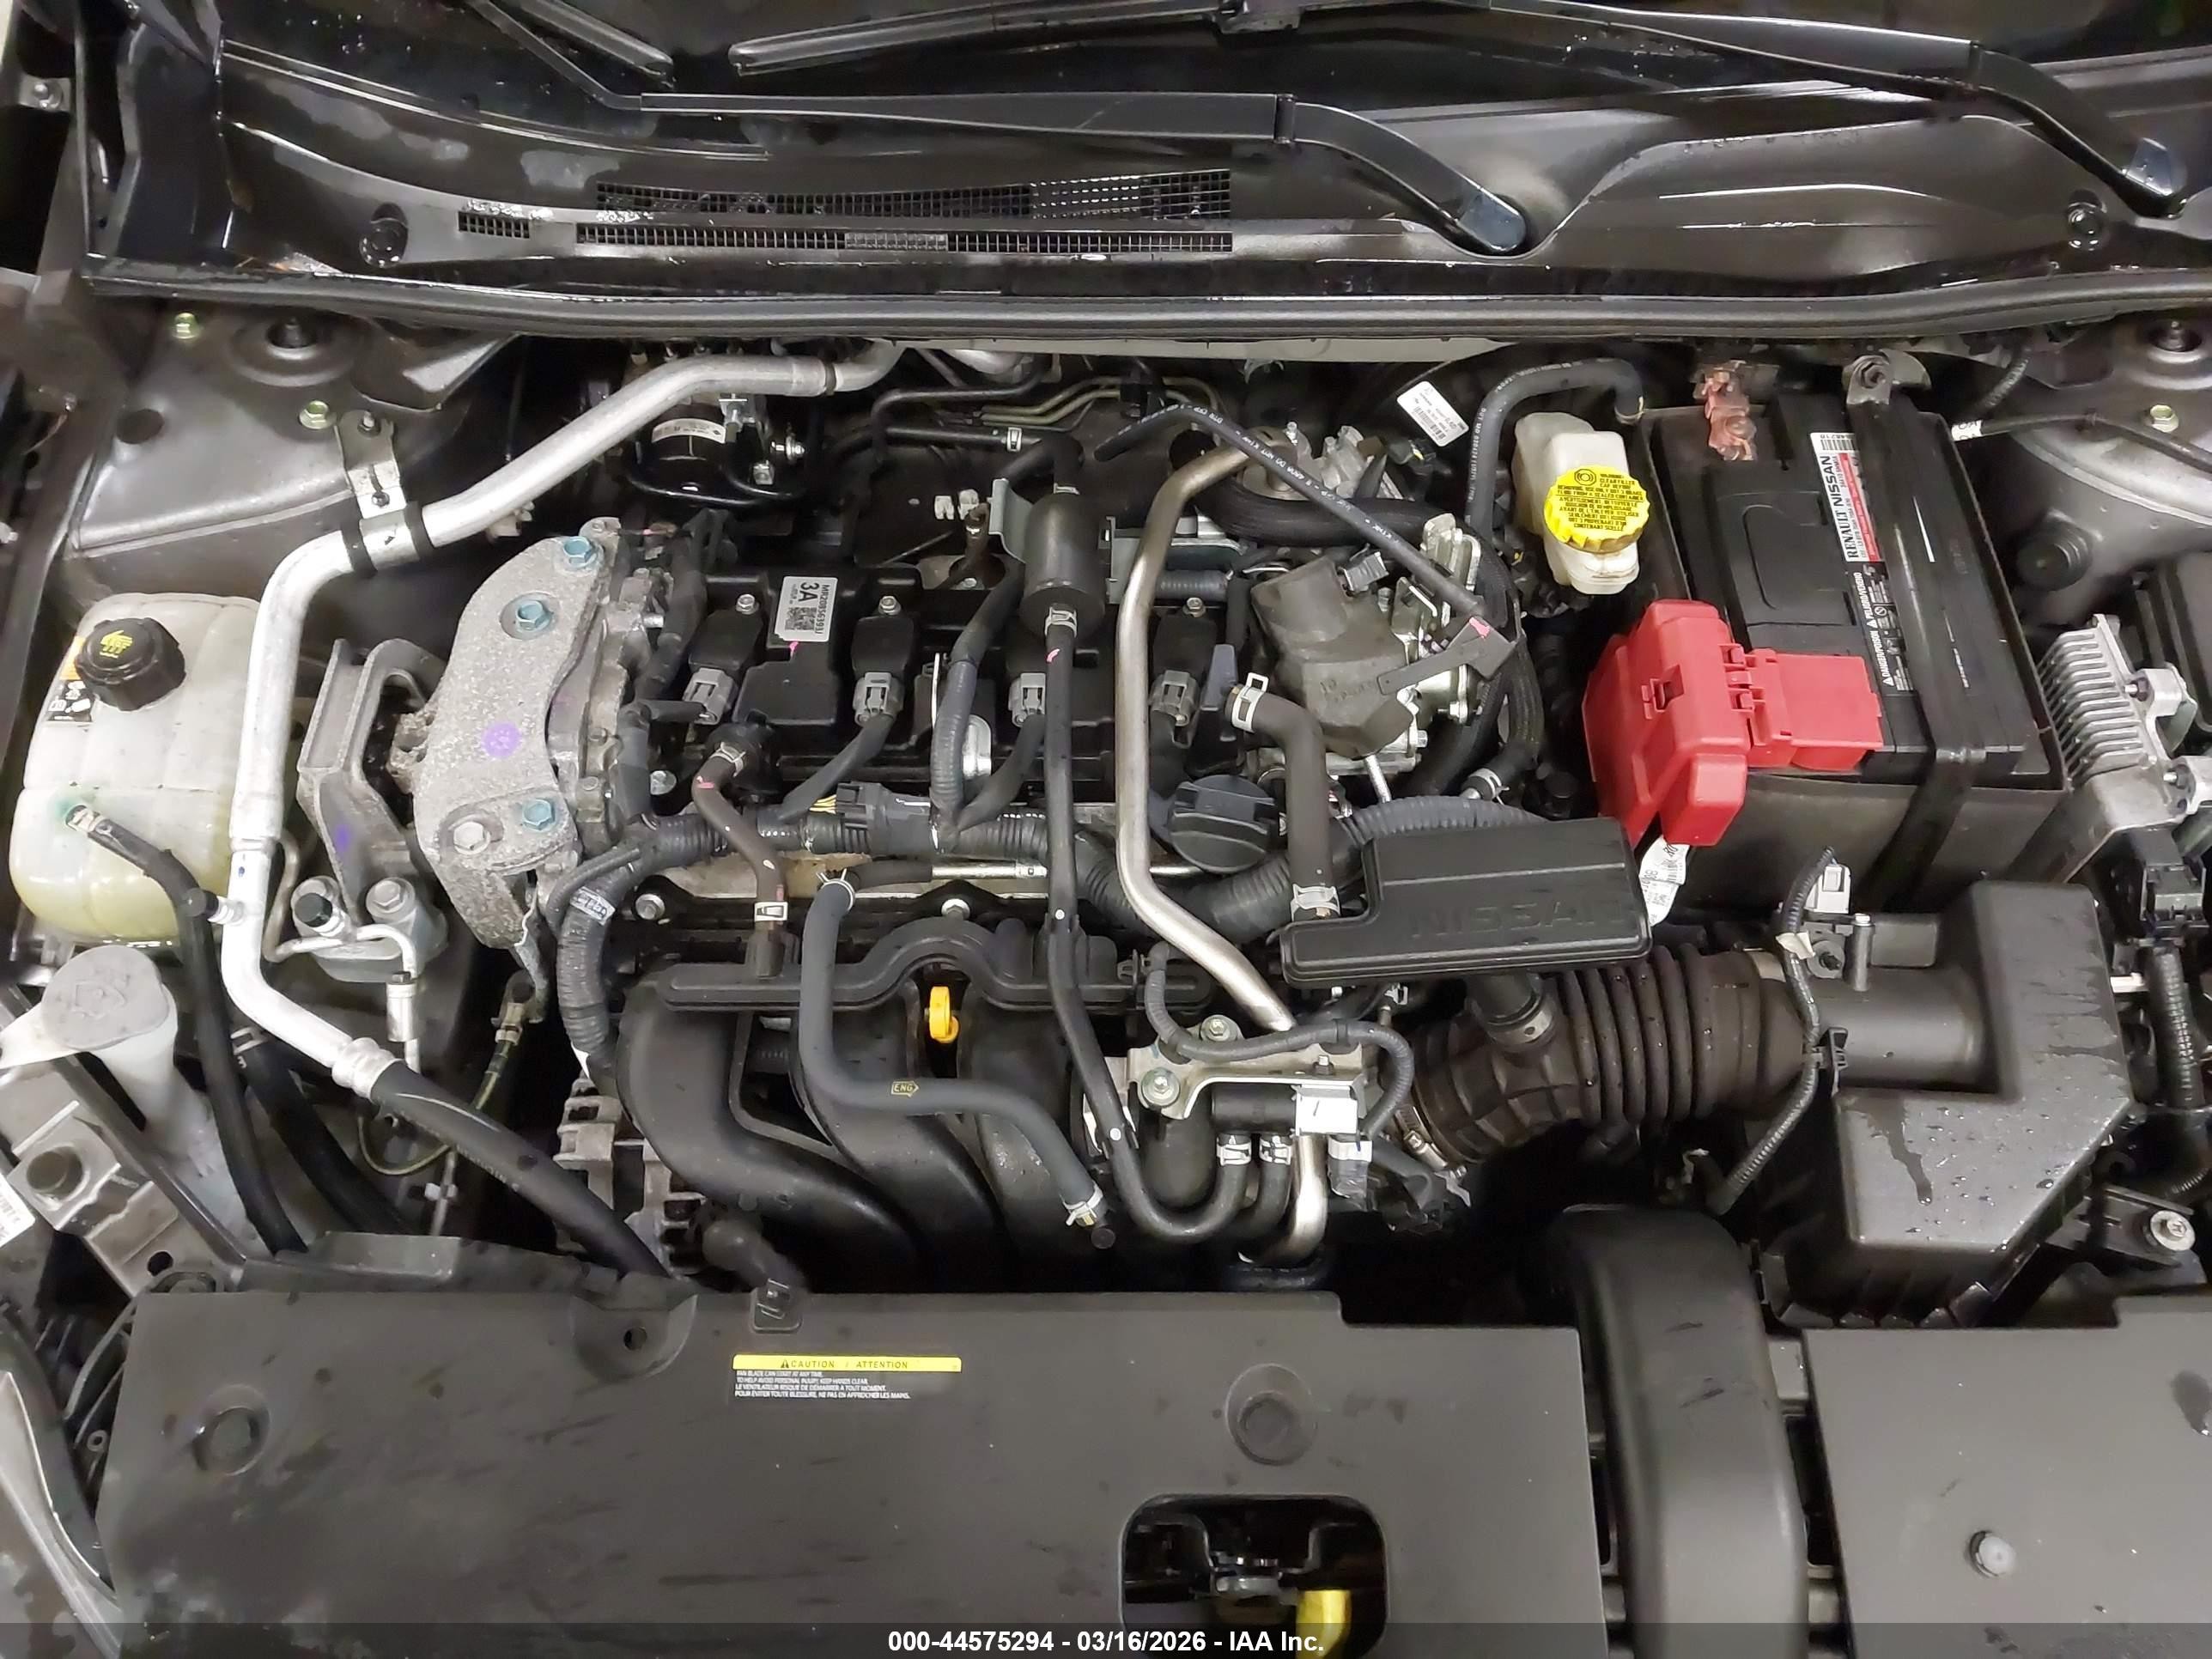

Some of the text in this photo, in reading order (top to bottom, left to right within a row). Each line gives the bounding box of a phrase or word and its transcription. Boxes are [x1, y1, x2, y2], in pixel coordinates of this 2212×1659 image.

[1820, 456, 1858, 558] RENAULT NISSAN
[799, 582, 819, 602] 3A
[1870, 631, 1890, 677] DANGER/POISON
[894, 1083, 914, 1092] ENG
